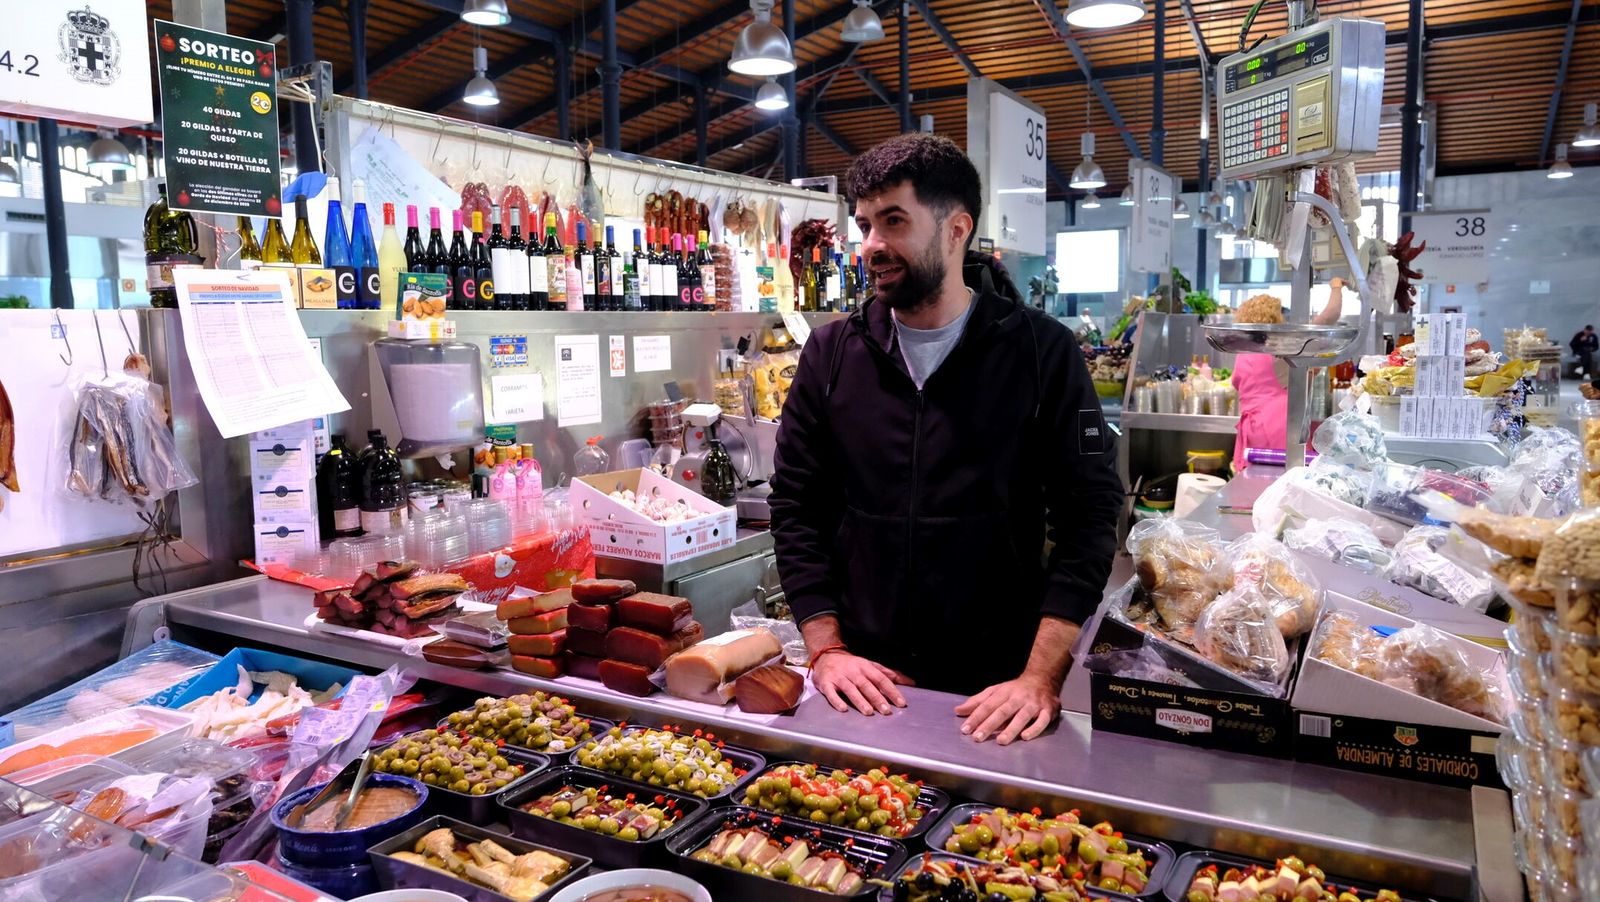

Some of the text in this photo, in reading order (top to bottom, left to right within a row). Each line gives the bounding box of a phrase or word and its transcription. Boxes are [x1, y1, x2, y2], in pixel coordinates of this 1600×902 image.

[179, 38, 254, 65] SORTEO
[181, 57, 255, 77] ¡PREMIO A ELEGIR!
[187, 68, 206, 76] NÚMERO
[252, 96, 269, 110] 2€
[214, 107, 241, 118] GILDAS
[181, 120, 191, 128] 20
[192, 122, 220, 133] GILDAS
[228, 127, 252, 137] TARTA
[210, 134, 236, 144] QUESO
[1026, 118, 1043, 160] 35
[190, 149, 218, 159] GILDAS
[225, 153, 257, 164] BOTELLA
[176, 156, 271, 174] VINO DE NUESTRA TIERRA
[1456, 217, 1485, 237] 38
[606, 546, 634, 558] ALVAREZ
[634, 549, 661, 560] MARCOS
[1159, 712, 1210, 728] DON GONZALO
[1336, 747, 1478, 779] CORDIALES DE ALMENDRA
